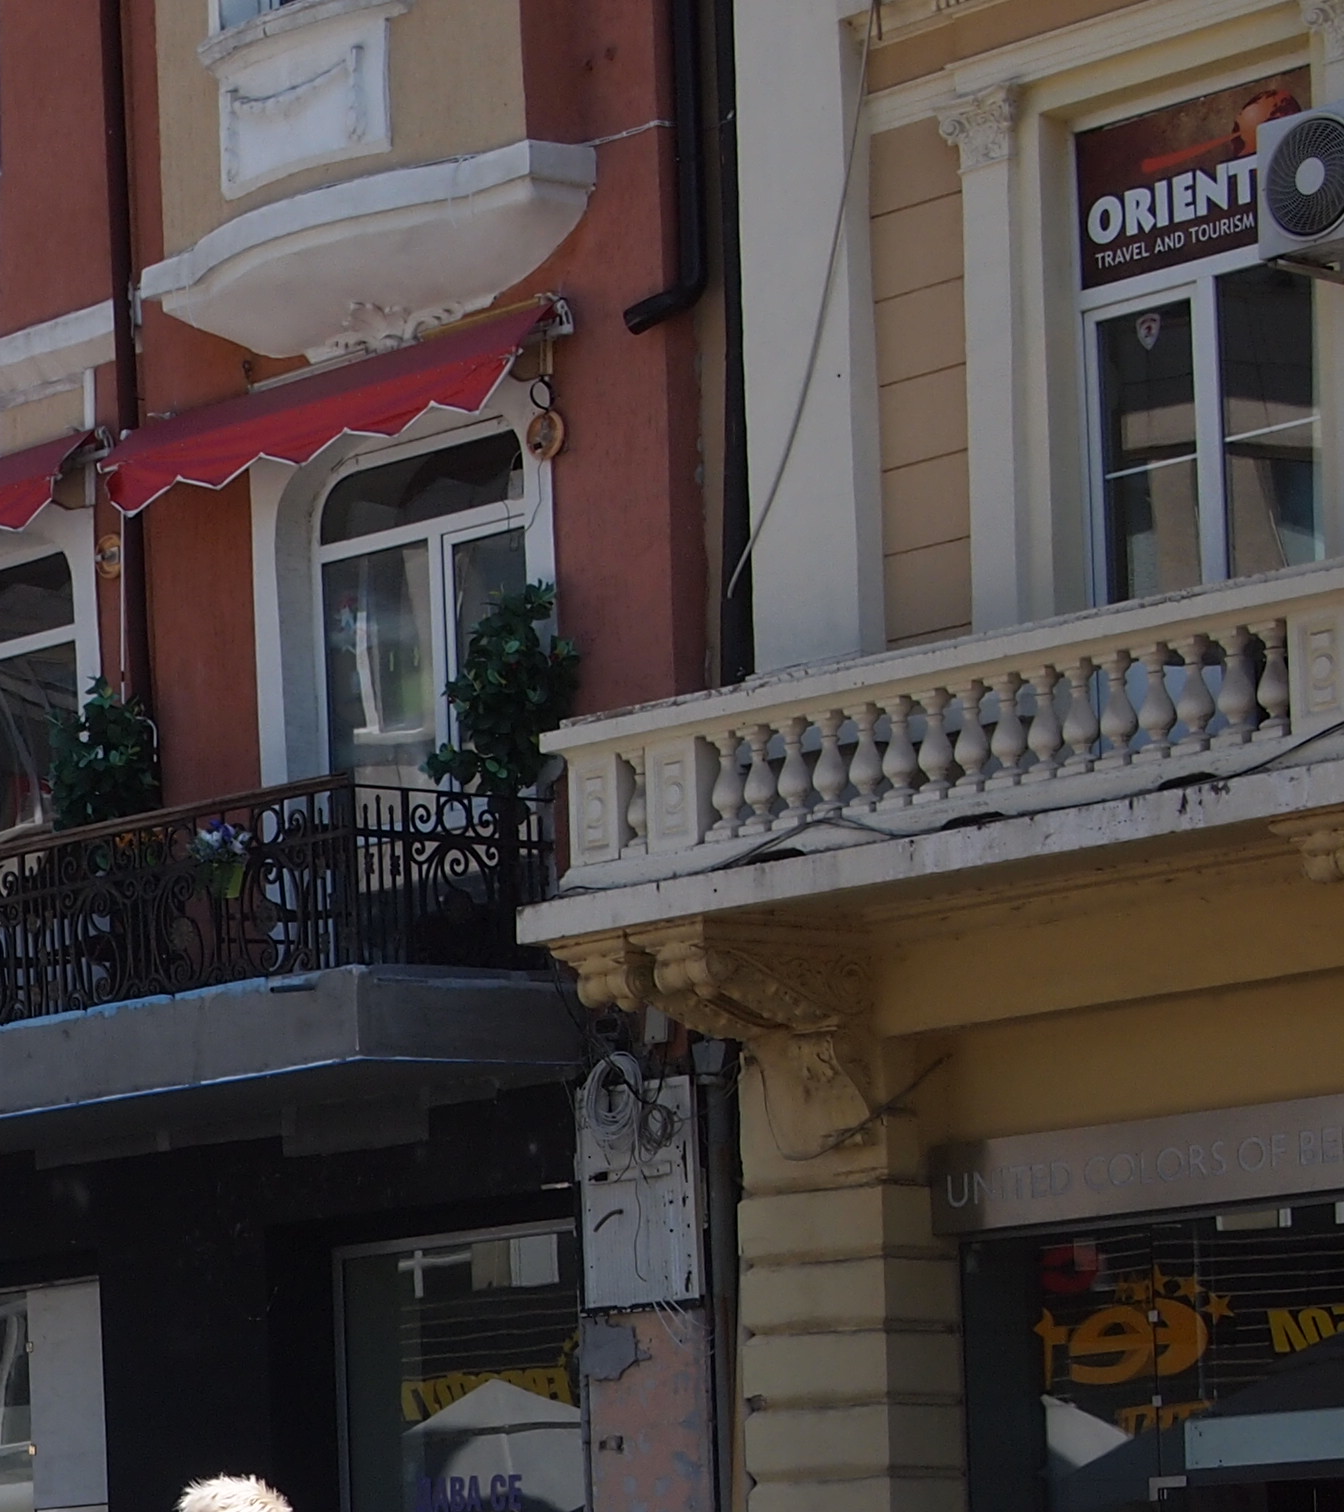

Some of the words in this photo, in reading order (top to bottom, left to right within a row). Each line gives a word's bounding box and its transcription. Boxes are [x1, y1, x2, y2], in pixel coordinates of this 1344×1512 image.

[1087, 154, 1258, 245] ORIENT
[1095, 242, 1150, 270] TRAVEL
[1154, 231, 1185, 254] AND
[1188, 212, 1255, 242] TOURISM
[946, 1160, 1072, 1208] UNITED
[1084, 1139, 1228, 1191] COLORS
[1236, 1133, 1288, 1174] OF
[1298, 1126, 1344, 1166] BE
